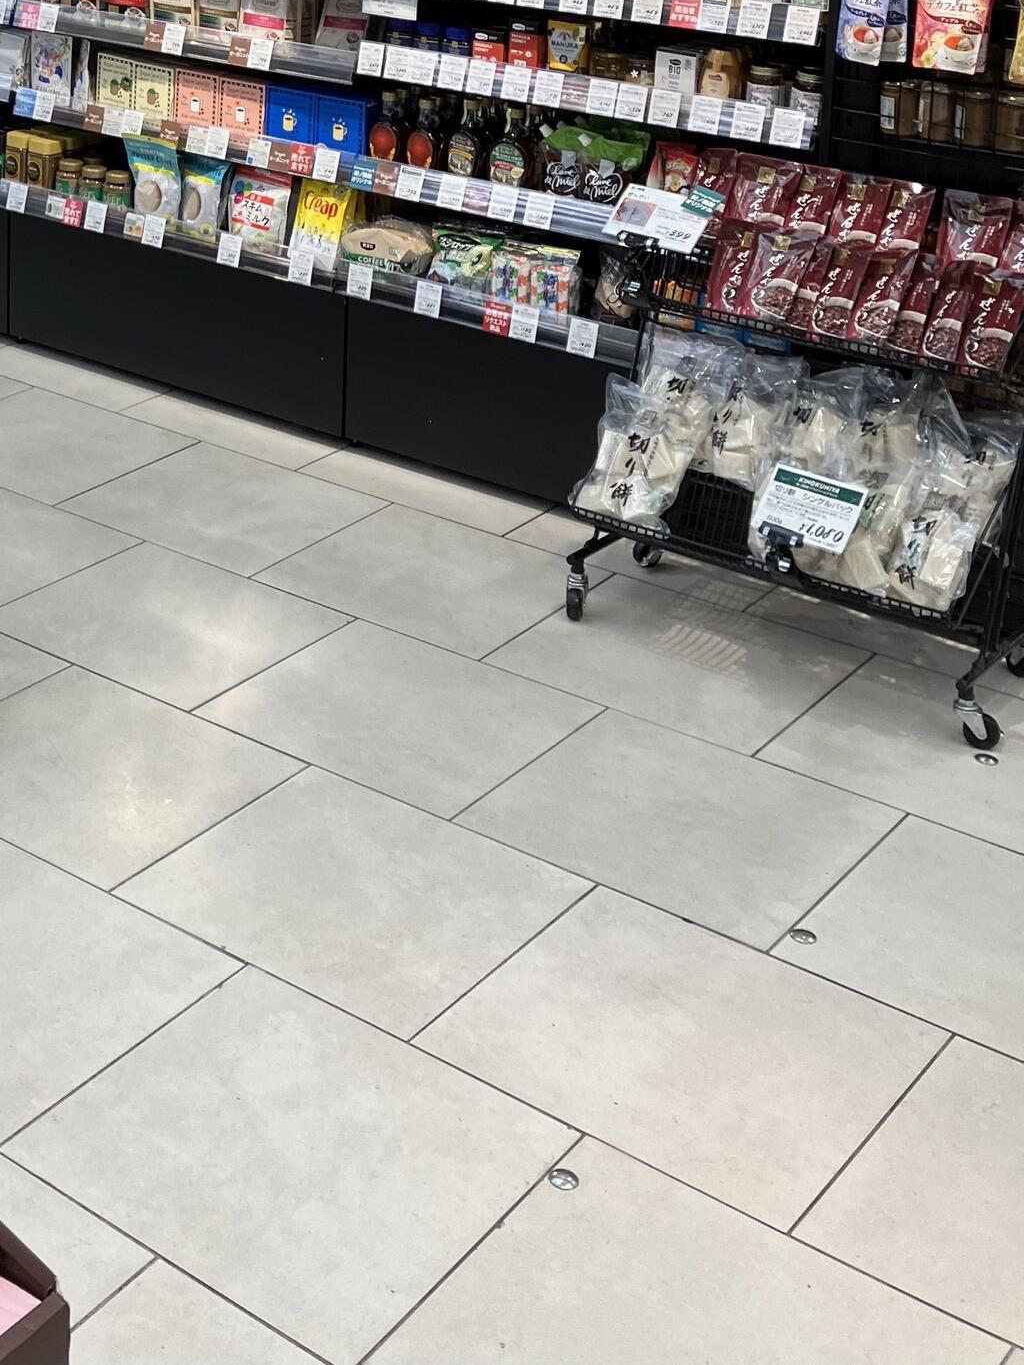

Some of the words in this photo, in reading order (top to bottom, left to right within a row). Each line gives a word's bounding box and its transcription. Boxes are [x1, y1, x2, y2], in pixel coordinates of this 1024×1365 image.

[927, 0, 980, 15] デカフェ紅茶
[551, 40, 579, 49] MANUKA
[242, 199, 263, 213] スキム
[304, 190, 339, 221] Creap
[245, 213, 270, 226] ミルク
[609, 432, 651, 507] 切り餅
[799, 477, 841, 494] KINOKUNIYA
[801, 493, 853, 514] シングルパック
